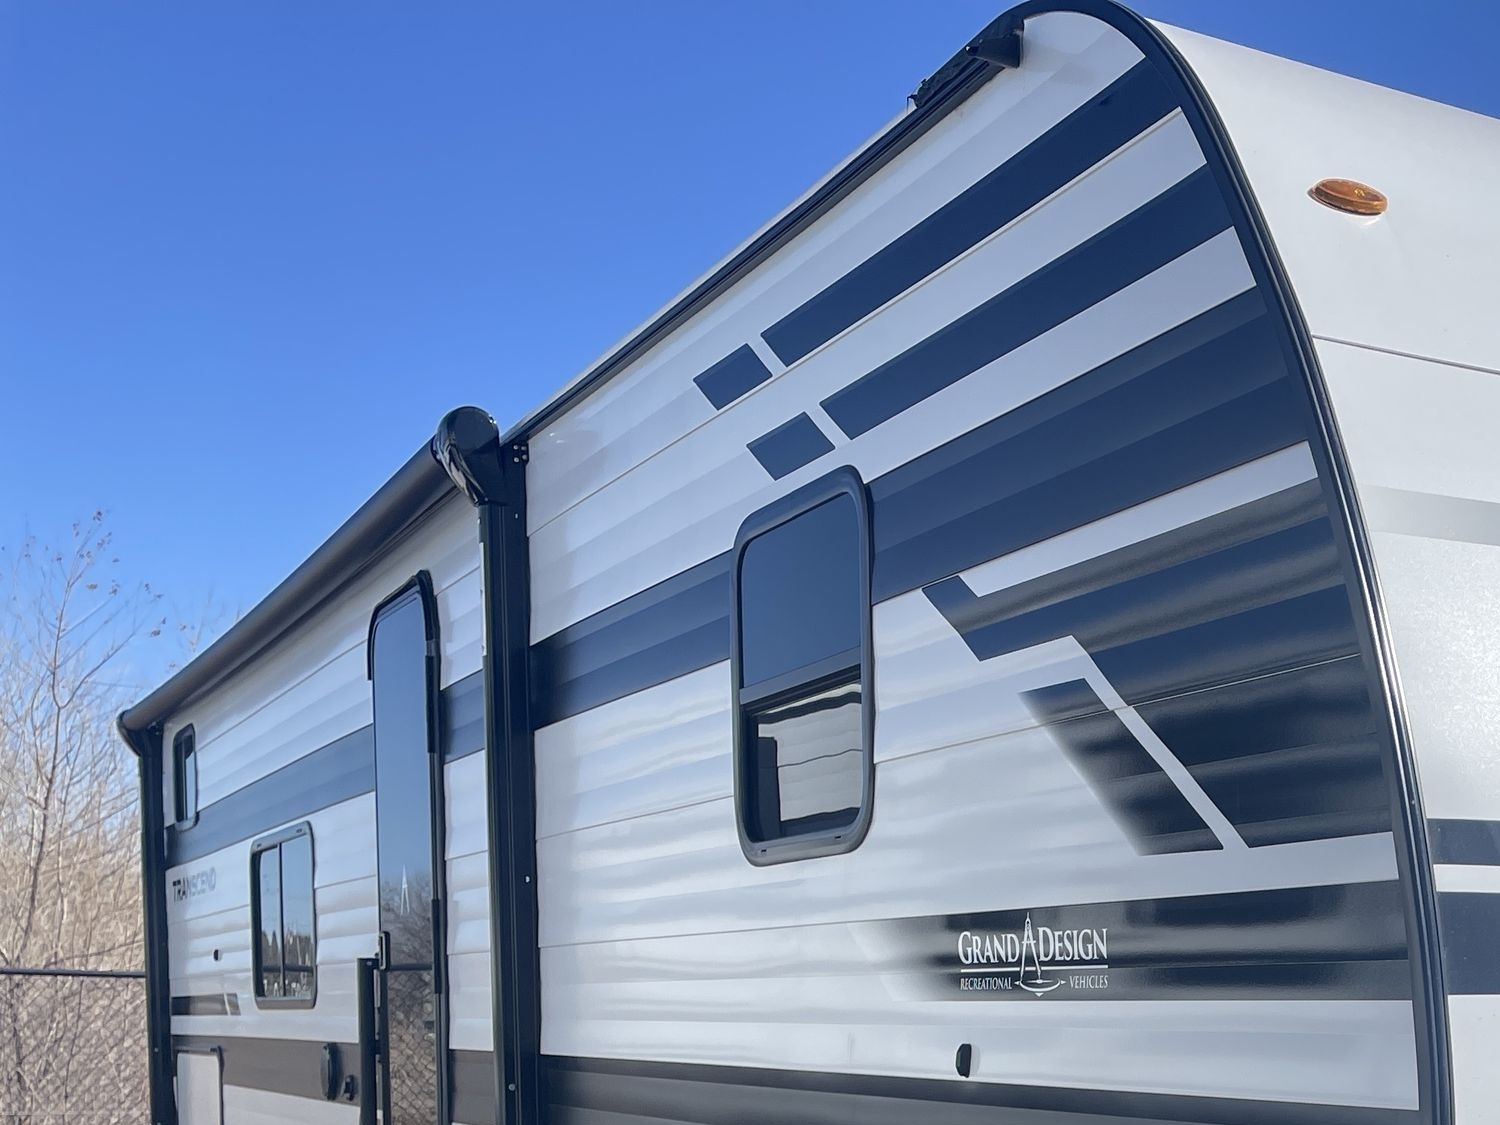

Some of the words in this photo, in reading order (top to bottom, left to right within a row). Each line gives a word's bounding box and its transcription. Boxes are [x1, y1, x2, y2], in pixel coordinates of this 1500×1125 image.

[957, 931, 1020, 965] GRAND
[1037, 925, 1108, 962] DESIGN
[960, 976, 1013, 991] RECREATIONAL
[1069, 975, 1108, 990] VEHICLES
